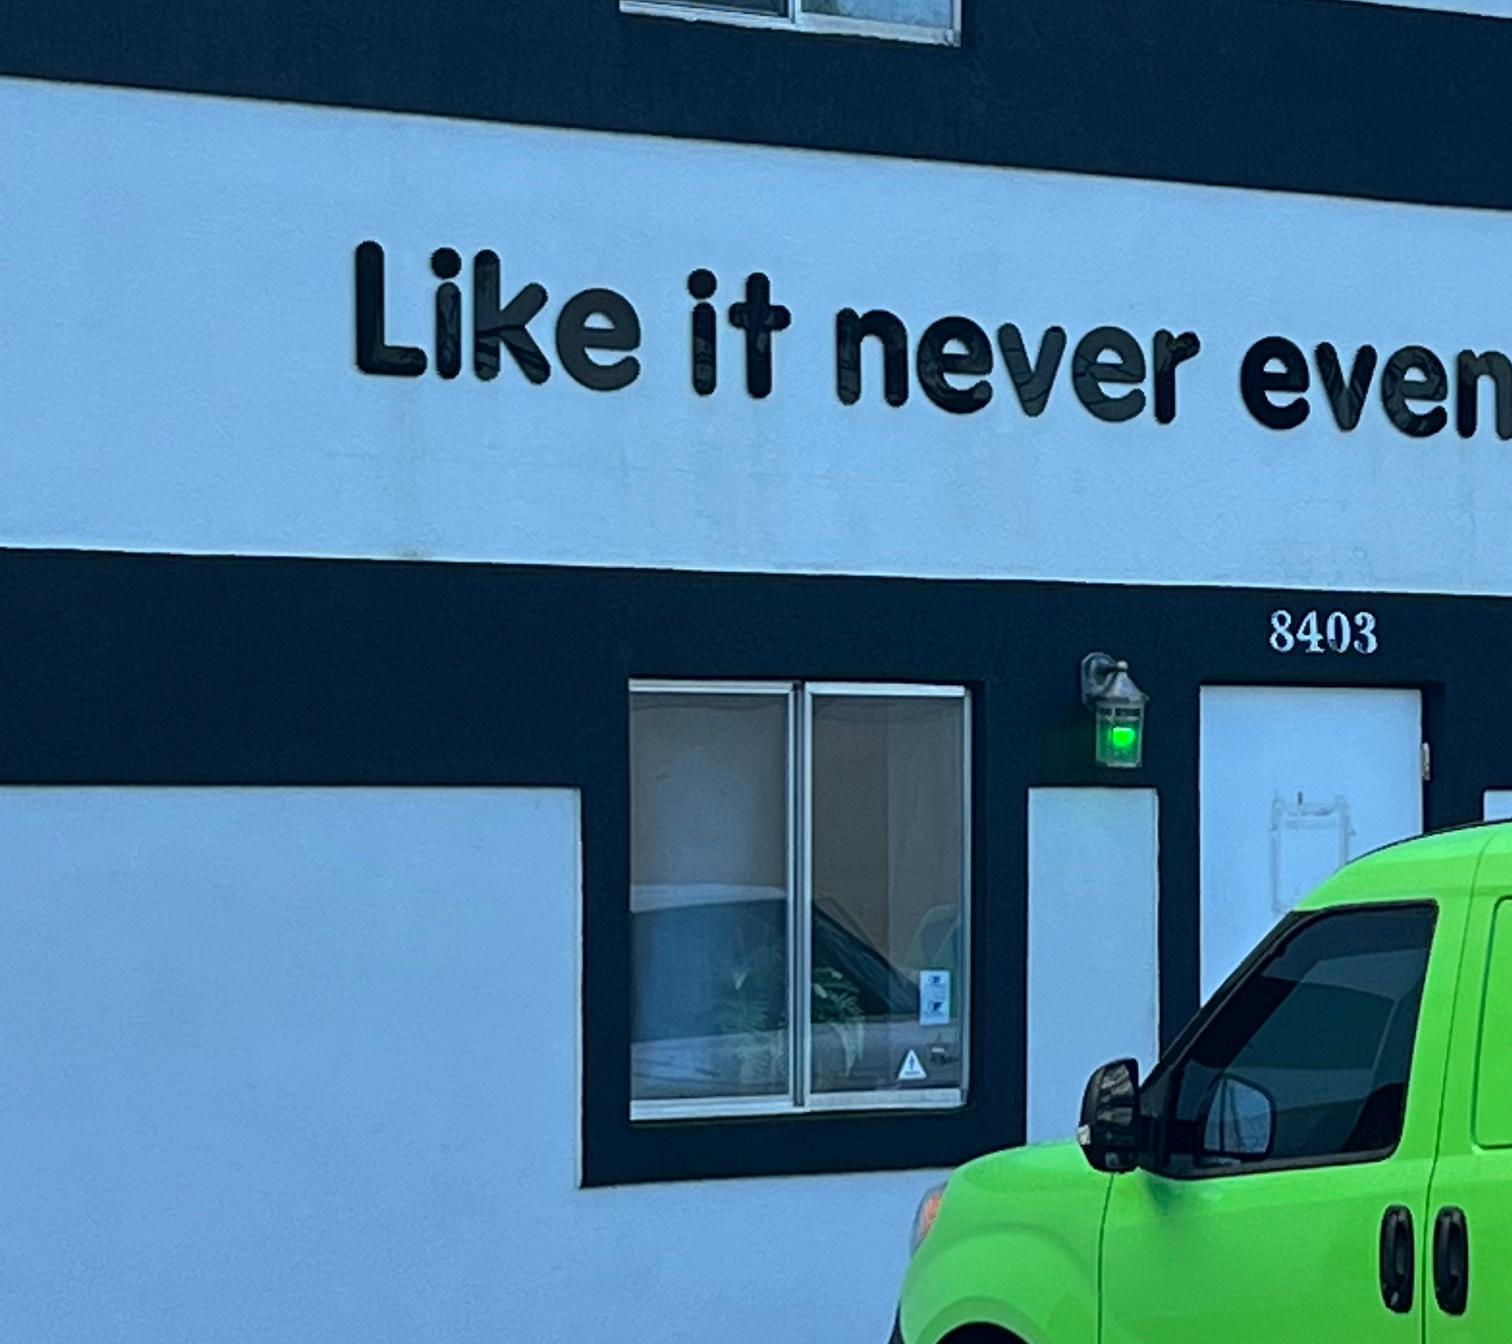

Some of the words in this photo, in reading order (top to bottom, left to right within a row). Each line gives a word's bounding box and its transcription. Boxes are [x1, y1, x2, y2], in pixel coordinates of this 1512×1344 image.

[355, 240, 641, 393] Like
[687, 268, 791, 399] it
[835, 308, 1200, 424] never
[1269, 609, 1378, 654] 8403
